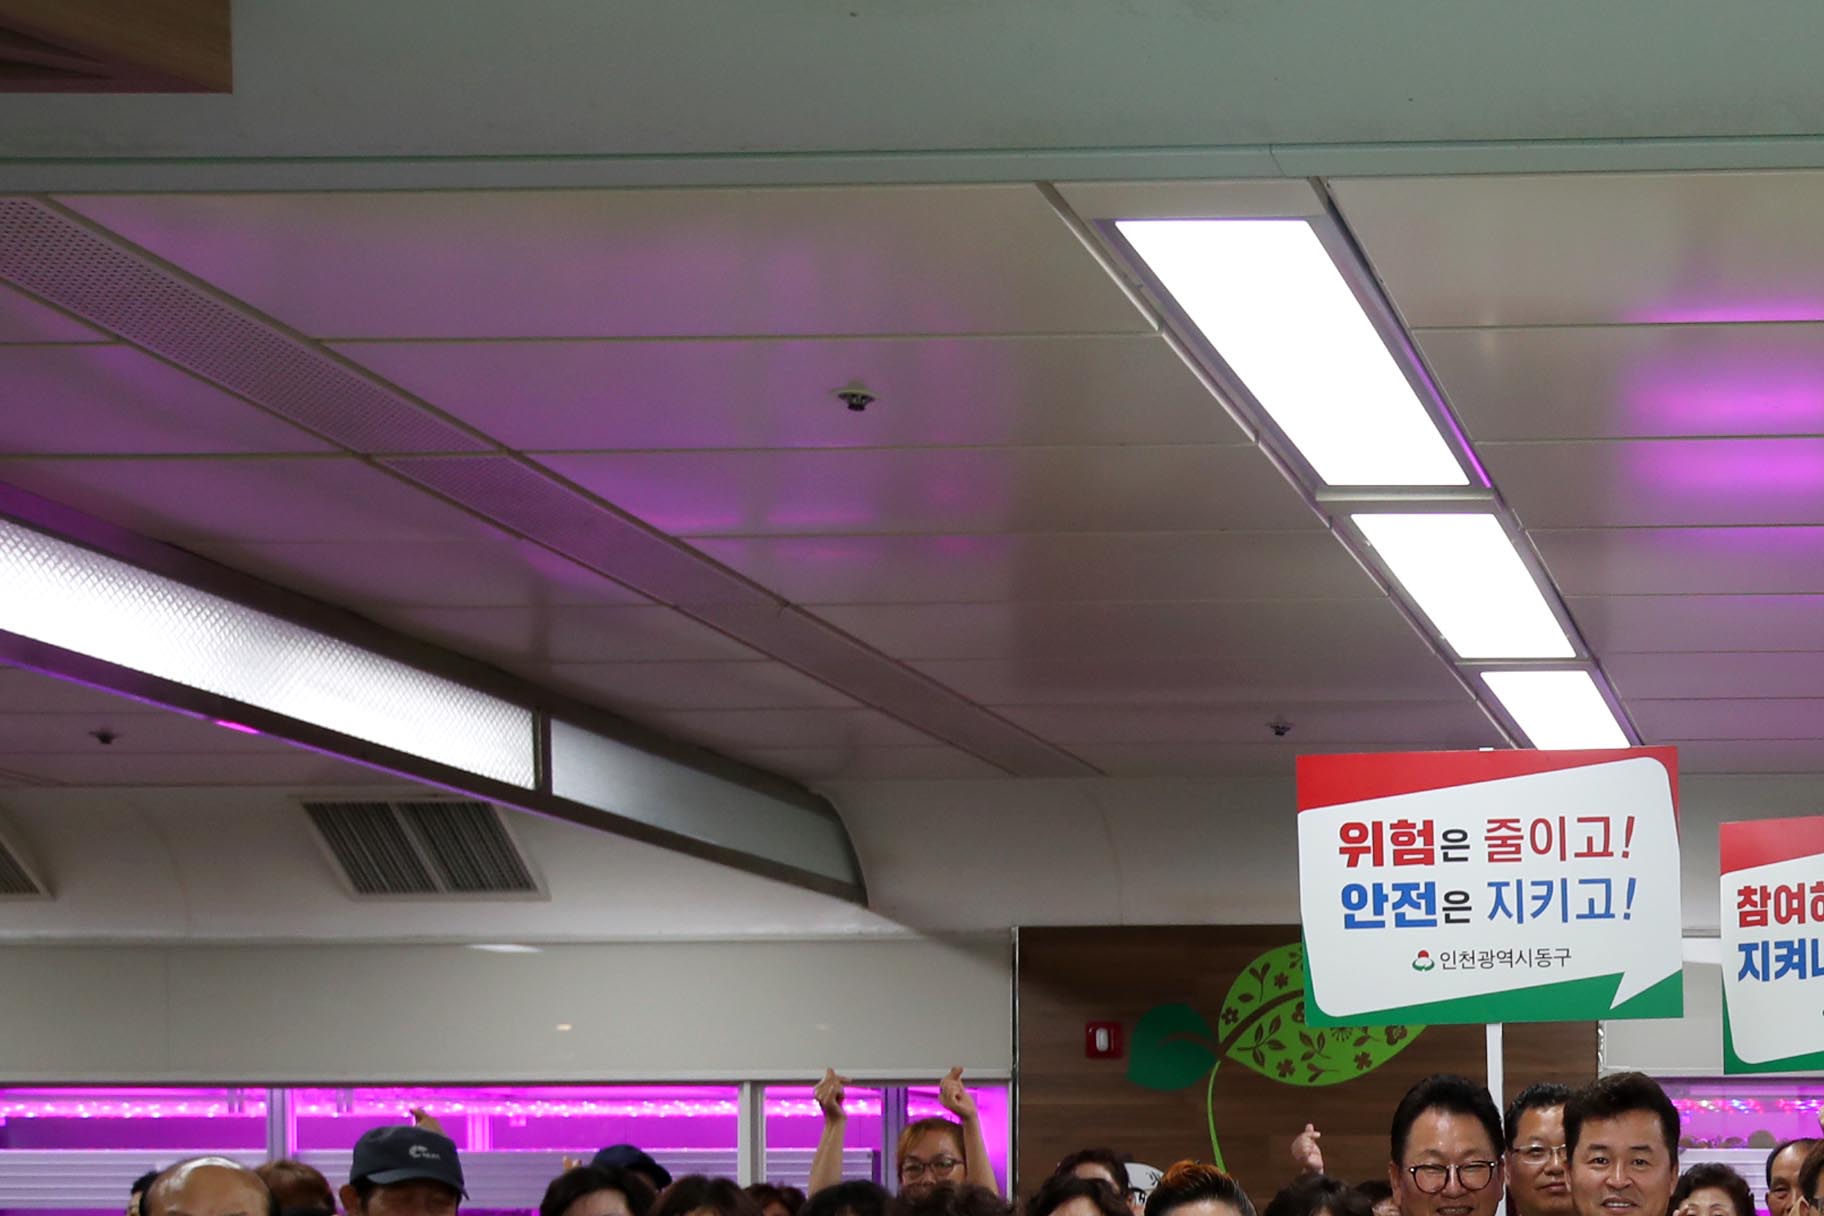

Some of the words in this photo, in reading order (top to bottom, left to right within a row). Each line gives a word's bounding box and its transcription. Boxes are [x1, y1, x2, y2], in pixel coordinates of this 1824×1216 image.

[1338, 820, 1471, 868] 위험은
[1483, 815, 1635, 863] 줄이고!
[1341, 882, 1473, 929] 안전은
[1486, 877, 1637, 925] 지키고!
[1439, 948, 1572, 970] 인천광역시동구
